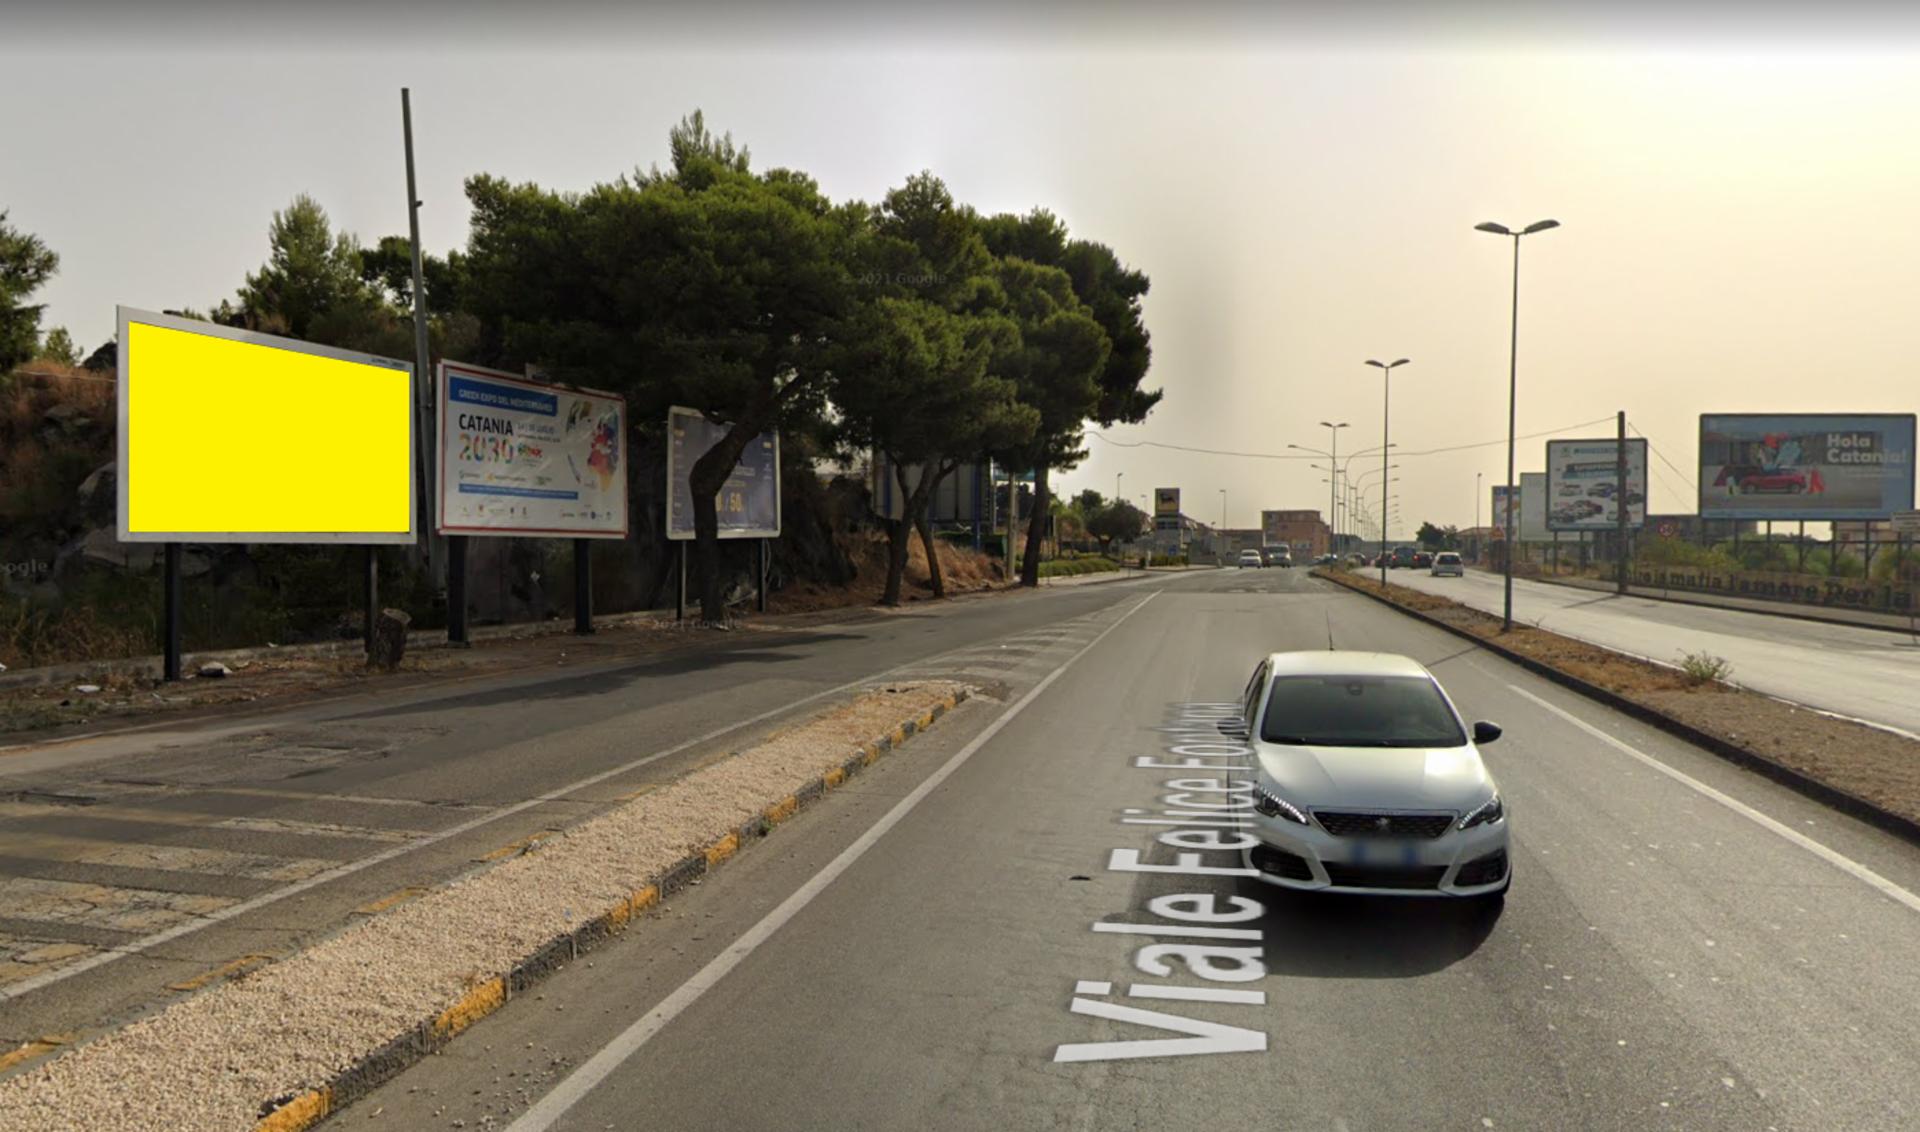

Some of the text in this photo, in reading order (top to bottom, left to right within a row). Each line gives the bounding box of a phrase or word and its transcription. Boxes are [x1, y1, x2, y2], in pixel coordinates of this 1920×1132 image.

[459, 413, 514, 437] CATANIA
[459, 433, 514, 464] 2030
[1827, 433, 1871, 448] Hola
[1827, 447, 1907, 464] Catania!
